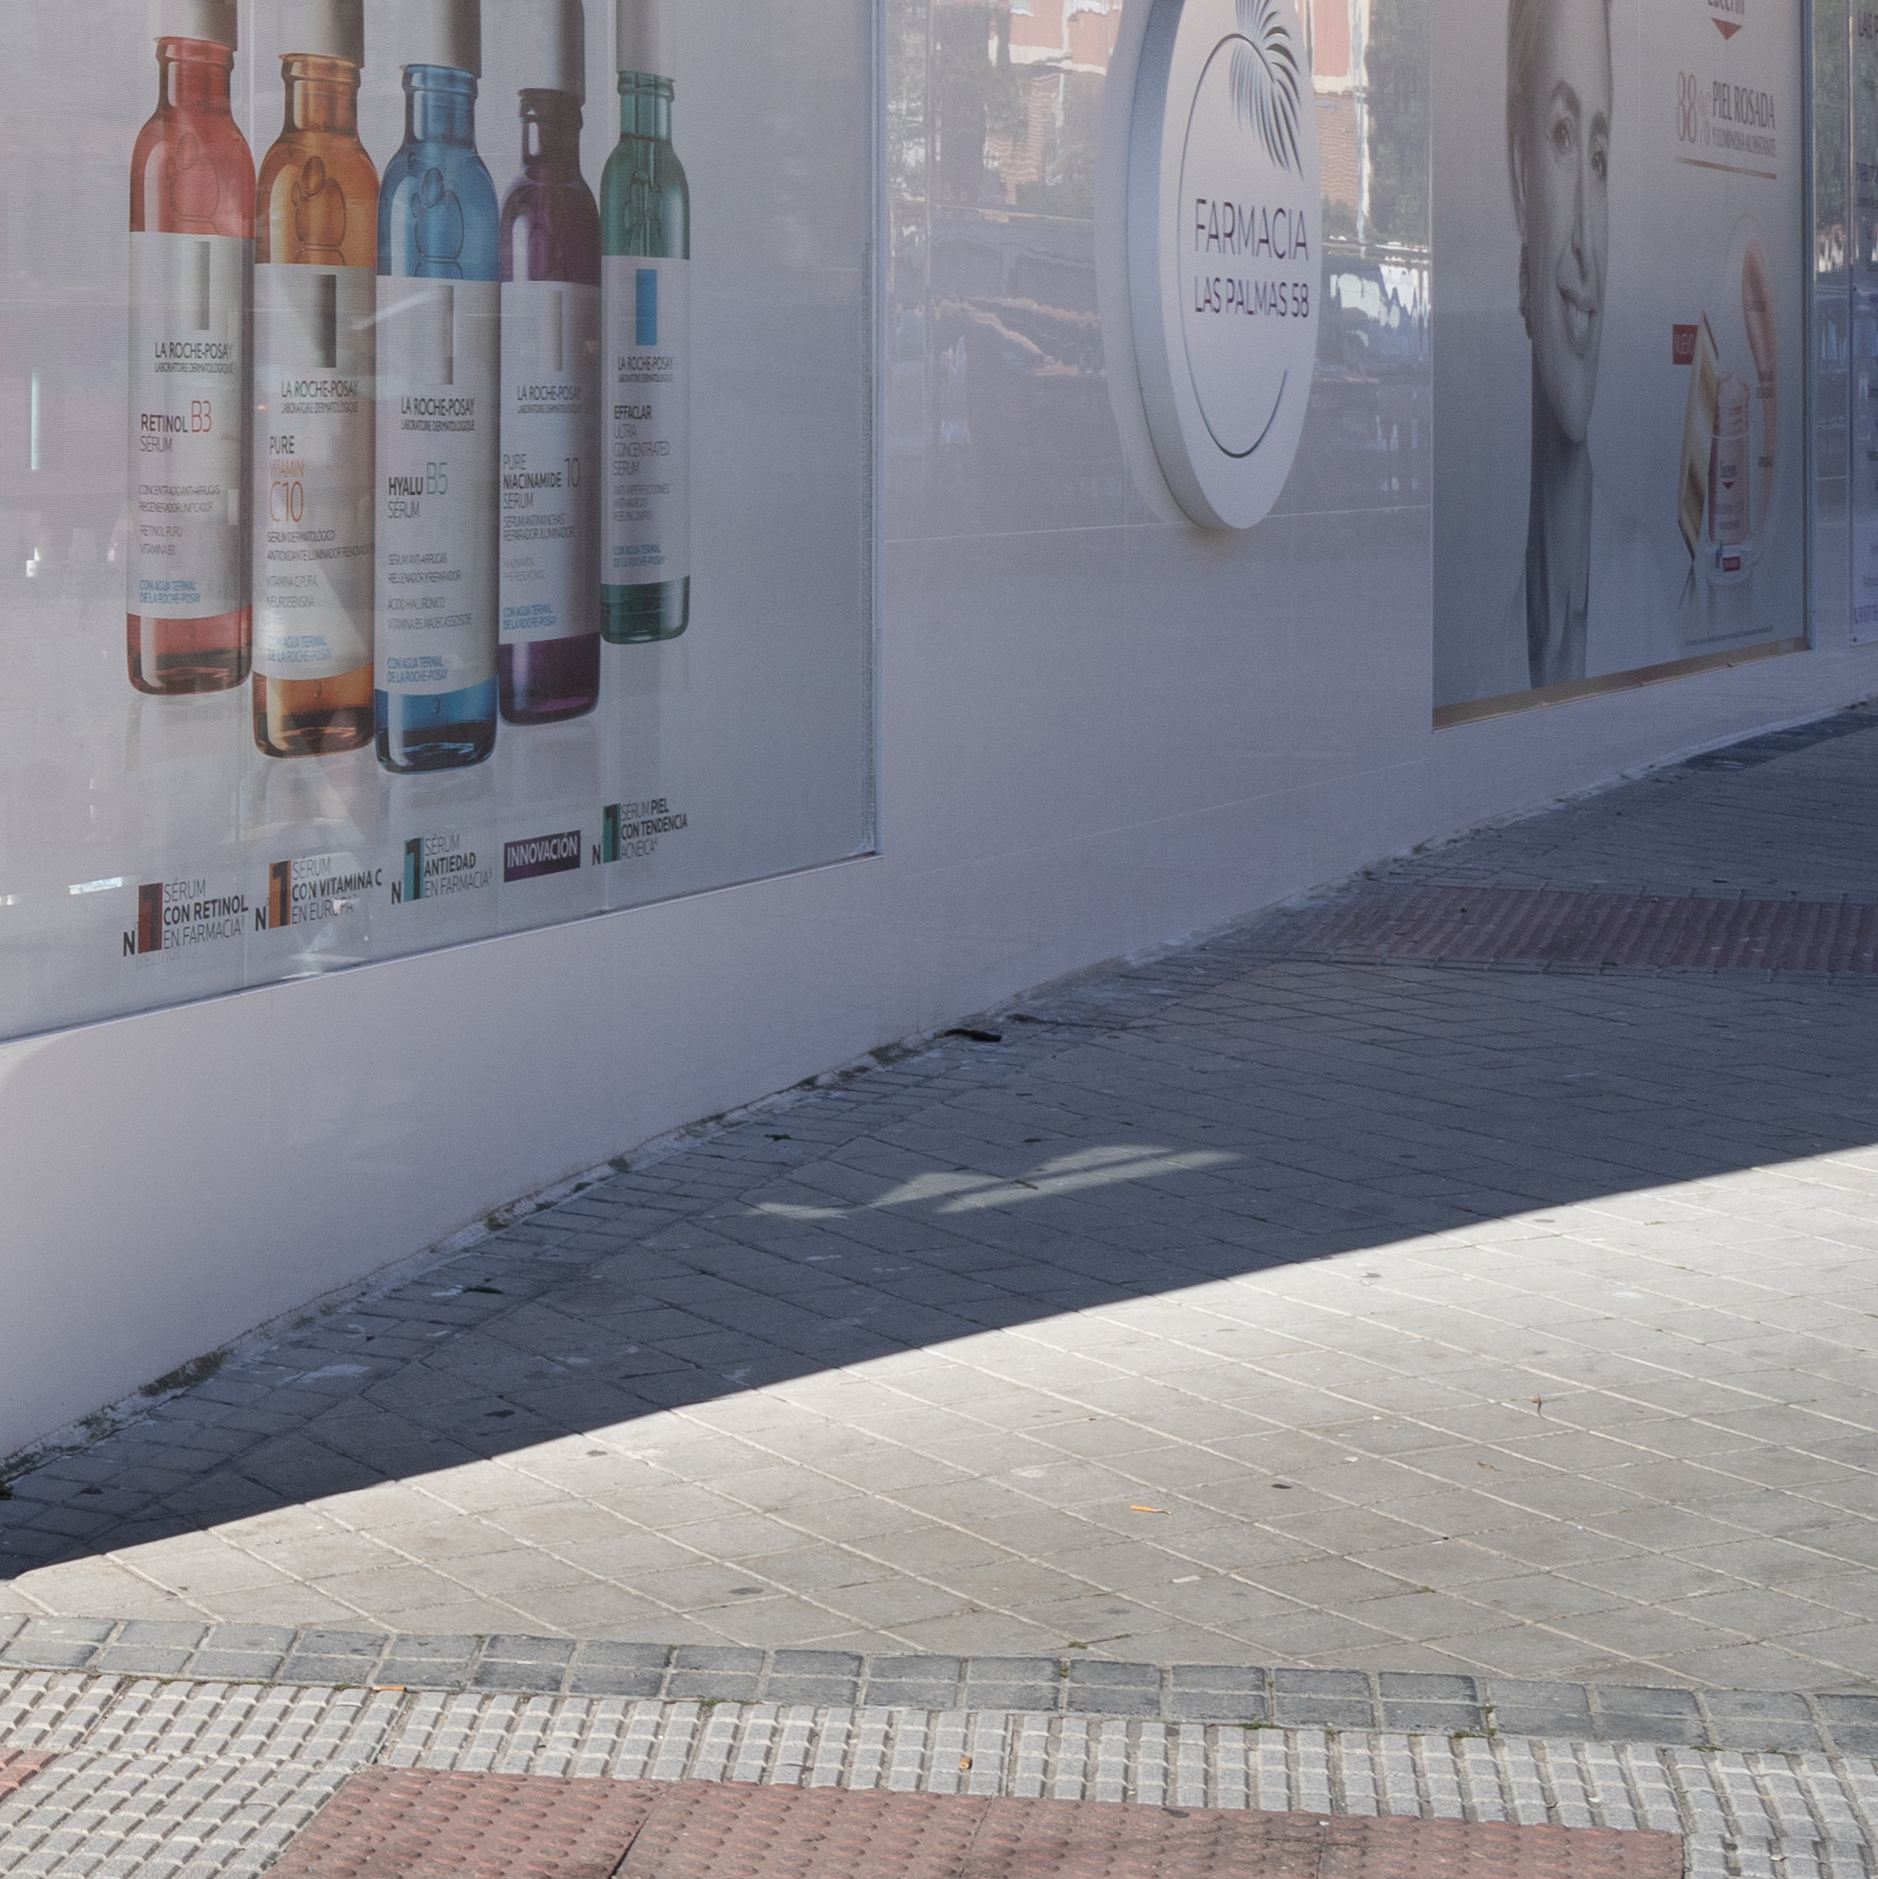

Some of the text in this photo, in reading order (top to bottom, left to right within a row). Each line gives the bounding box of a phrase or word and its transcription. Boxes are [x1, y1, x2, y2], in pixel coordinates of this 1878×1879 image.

[1712, 80, 1733, 122] PIEL
[1734, 85, 1776, 131] ROSADA
[1195, 198, 1309, 261] FARMACIA
[1195, 275, 1310, 318] LAS PALMAS 58
[155, 341, 234, 360] LA ROCHE-POSAY
[626, 357, 673, 371] ROCHE-POSAY
[281, 380, 359, 398] LA ROCHE-POSAY
[517, 385, 582, 401] LA ROCHE-POSAY
[141, 400, 212, 433] RETINOL B3
[401, 397, 475, 416] LA ROCHE-POSAY
[614, 405, 652, 420] EFFACLAR
[140, 432, 173, 453] SÉRUM
[269, 435, 295, 455] PURE
[269, 459, 305, 478] VITAMIN
[503, 454, 526, 470] PURE
[503, 457, 580, 490] NIACINAMIDE 10
[388, 462, 448, 496] HYALU B5
[269, 481, 304, 524] C10
[388, 498, 420, 519] SÉRUM
[622, 798, 669, 823] SÉRUM PIEL
[621, 812, 688, 839] CON TENDENCIA
[424, 833, 460, 857] SÉRUM
[507, 831, 578, 868] INNOVACIÓN
[292, 857, 331, 881] SÉRUM
[424, 851, 476, 877] ANTIEDAD
[164, 878, 206, 904] SÉRUM
[292, 868, 383, 902] CON VITAMINA C
[424, 878, 439, 899] EN
[163, 895, 249, 926] CON RETINOL
[292, 905, 308, 924] EN
[163, 928, 180, 950] EN
